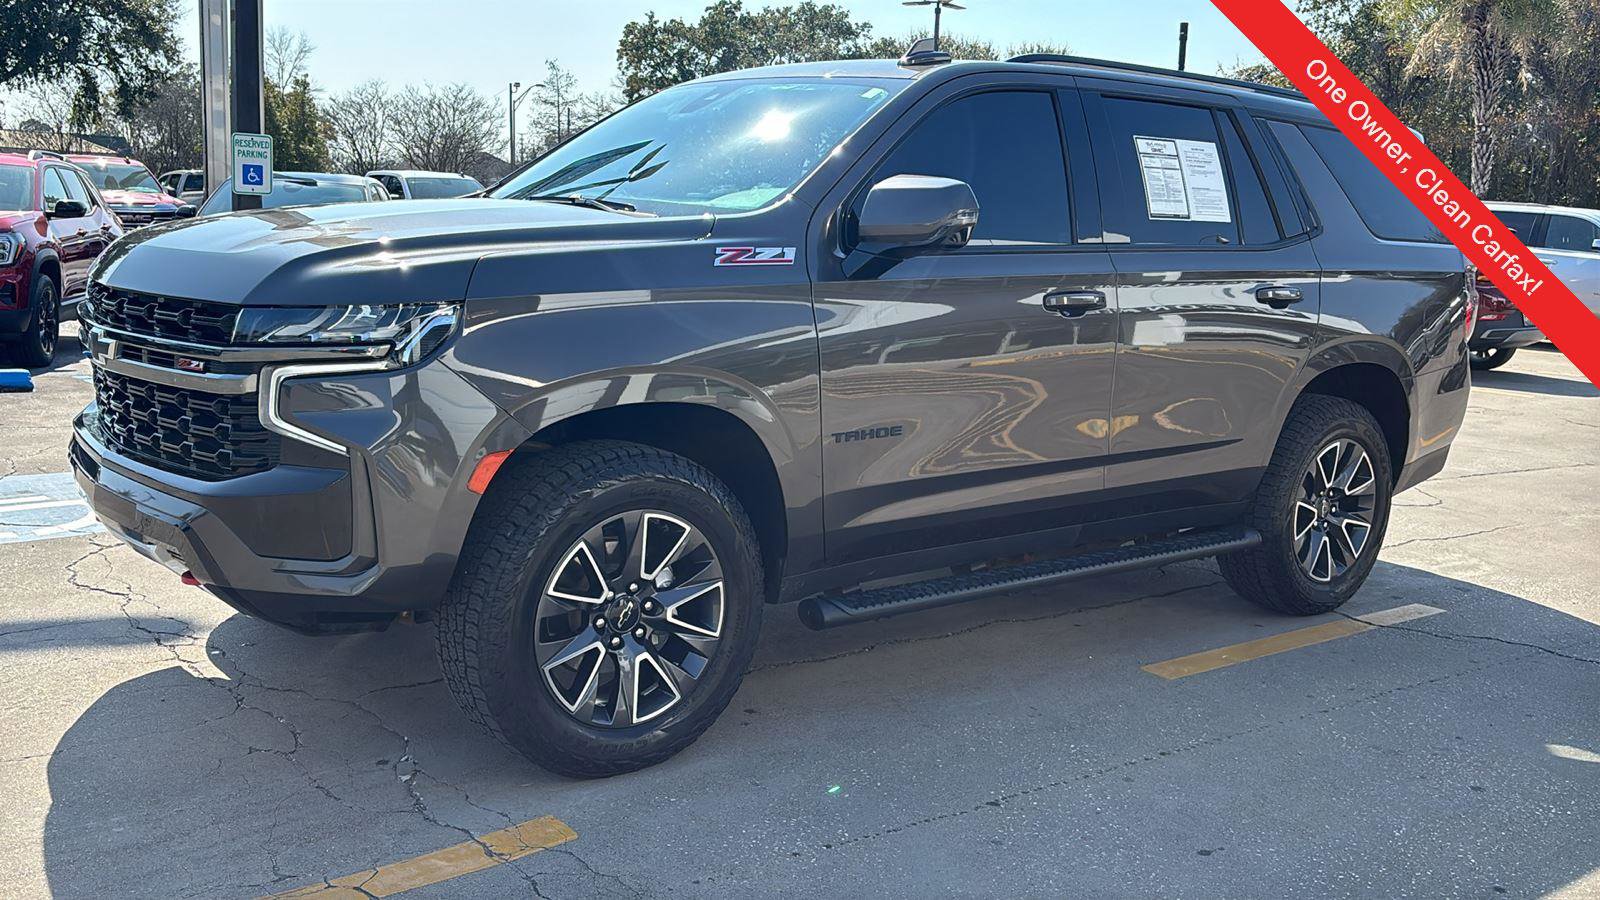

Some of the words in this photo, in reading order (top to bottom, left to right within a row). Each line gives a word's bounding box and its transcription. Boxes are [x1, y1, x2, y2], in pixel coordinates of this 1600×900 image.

[234, 139, 270, 149] RESERVED
[237, 149, 268, 159] PARKING
[714, 247, 797, 266] Z71
[831, 425, 903, 443] TAHOE
